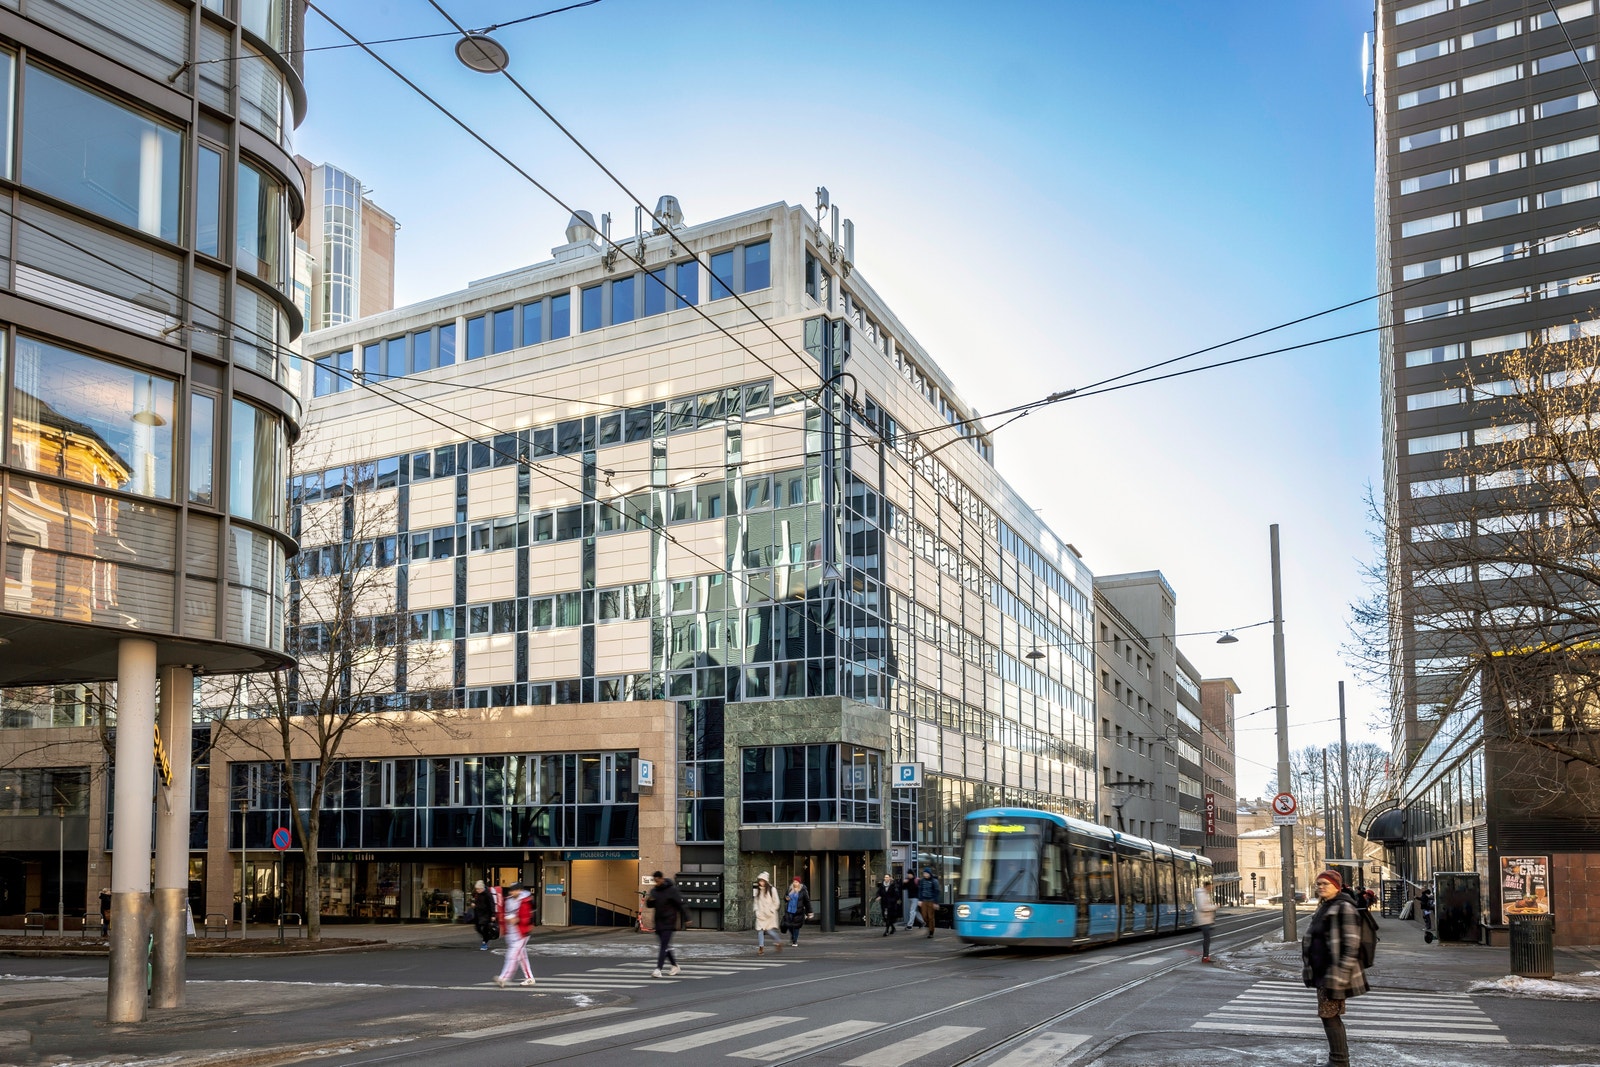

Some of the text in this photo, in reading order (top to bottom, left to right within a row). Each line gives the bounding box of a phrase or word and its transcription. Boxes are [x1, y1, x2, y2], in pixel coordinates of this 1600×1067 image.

[1206, 797, 1214, 833] HOTEL
[1519, 865, 1546, 876] GRIS
[1505, 875, 1519, 883] BAR
[1505, 881, 1523, 890] GRILL
